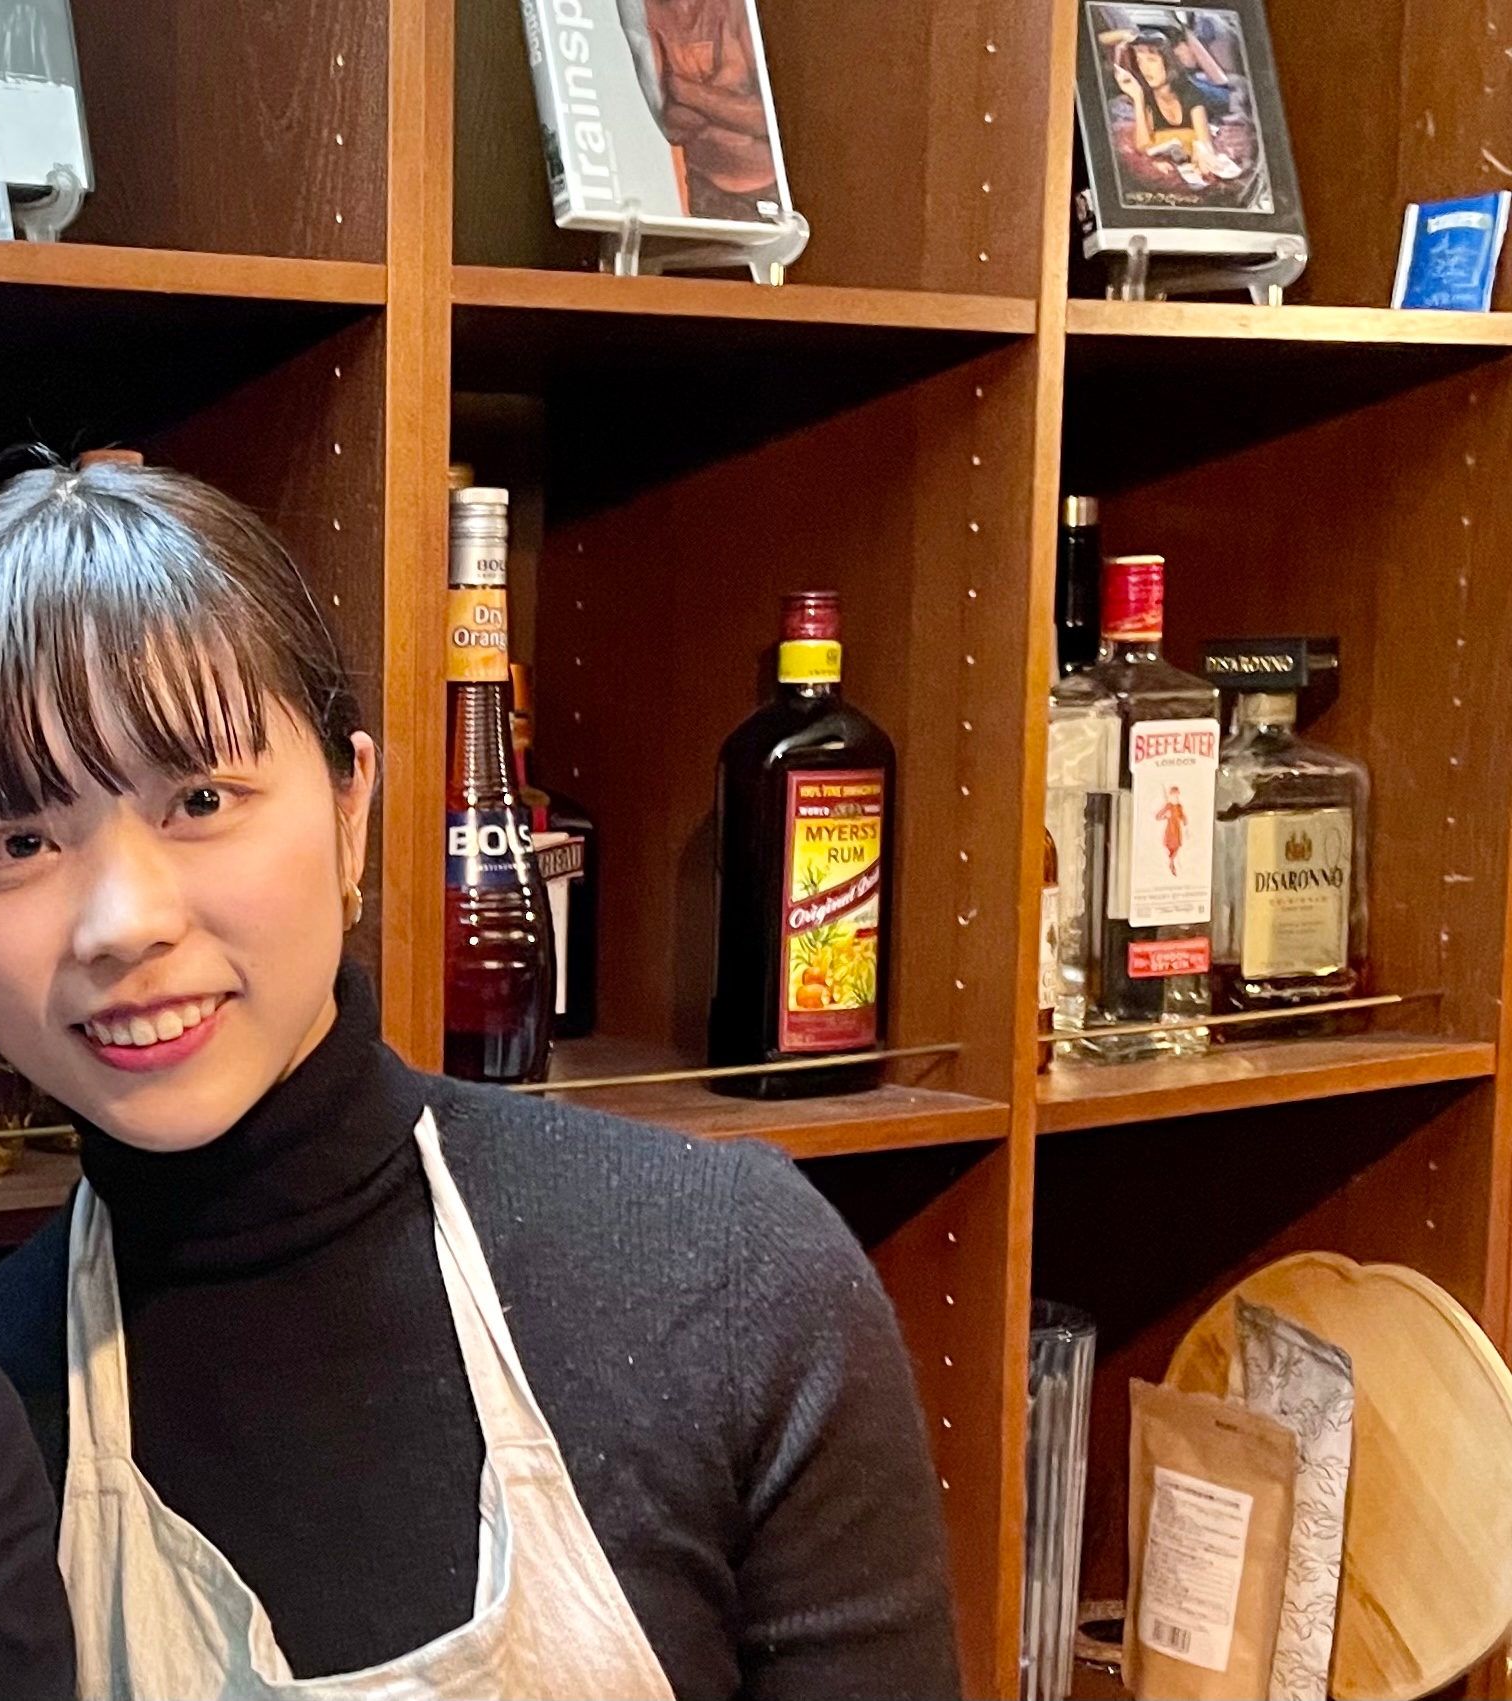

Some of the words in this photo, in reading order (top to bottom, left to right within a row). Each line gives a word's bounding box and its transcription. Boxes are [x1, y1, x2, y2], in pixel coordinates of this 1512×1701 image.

[1134, 731, 1216, 765] BEEFEATER
[448, 824, 534, 856] BOLS
[828, 846, 865, 864] RUM
[1254, 864, 1344, 893] DISARONNO
